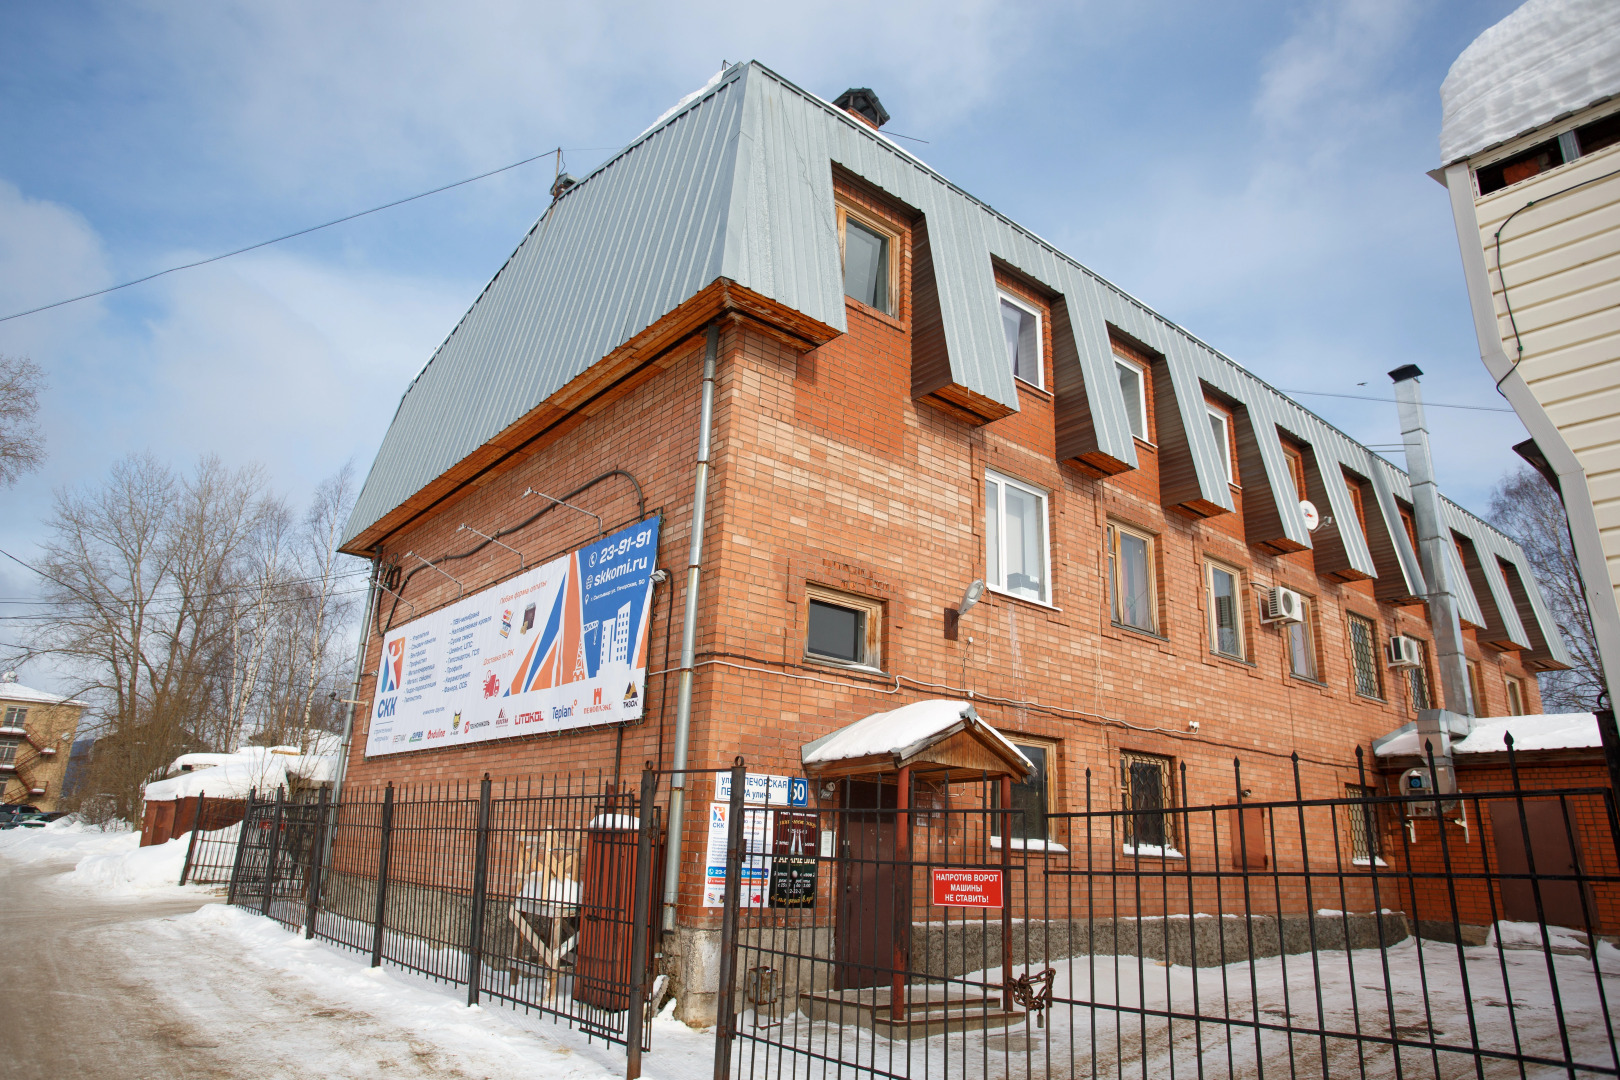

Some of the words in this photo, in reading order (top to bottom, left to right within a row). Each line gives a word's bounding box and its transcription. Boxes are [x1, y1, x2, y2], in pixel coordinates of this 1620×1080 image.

[600, 529, 652, 564] 23-91-91
[594, 556, 647, 586] skkomi.ru
[500, 595, 514, 605] Любая
[514, 588, 529, 600] форма
[530, 580, 547, 593] оплаты
[483, 655, 501, 666] Доставка
[377, 696, 398, 718] СКК
[552, 704, 574, 722] Teplant
[514, 710, 545, 725] LITOKOL
[427, 728, 446, 740] Onduline
[790, 782, 805, 801] 50
[935, 873, 972, 882] НАПРОТИВ
[973, 874, 998, 882] ВОРОТ
[950, 883, 983, 892] МАШИНЫ
[944, 893, 954, 901] НЕ
[955, 894, 989, 903] СТАВИТЬ!
